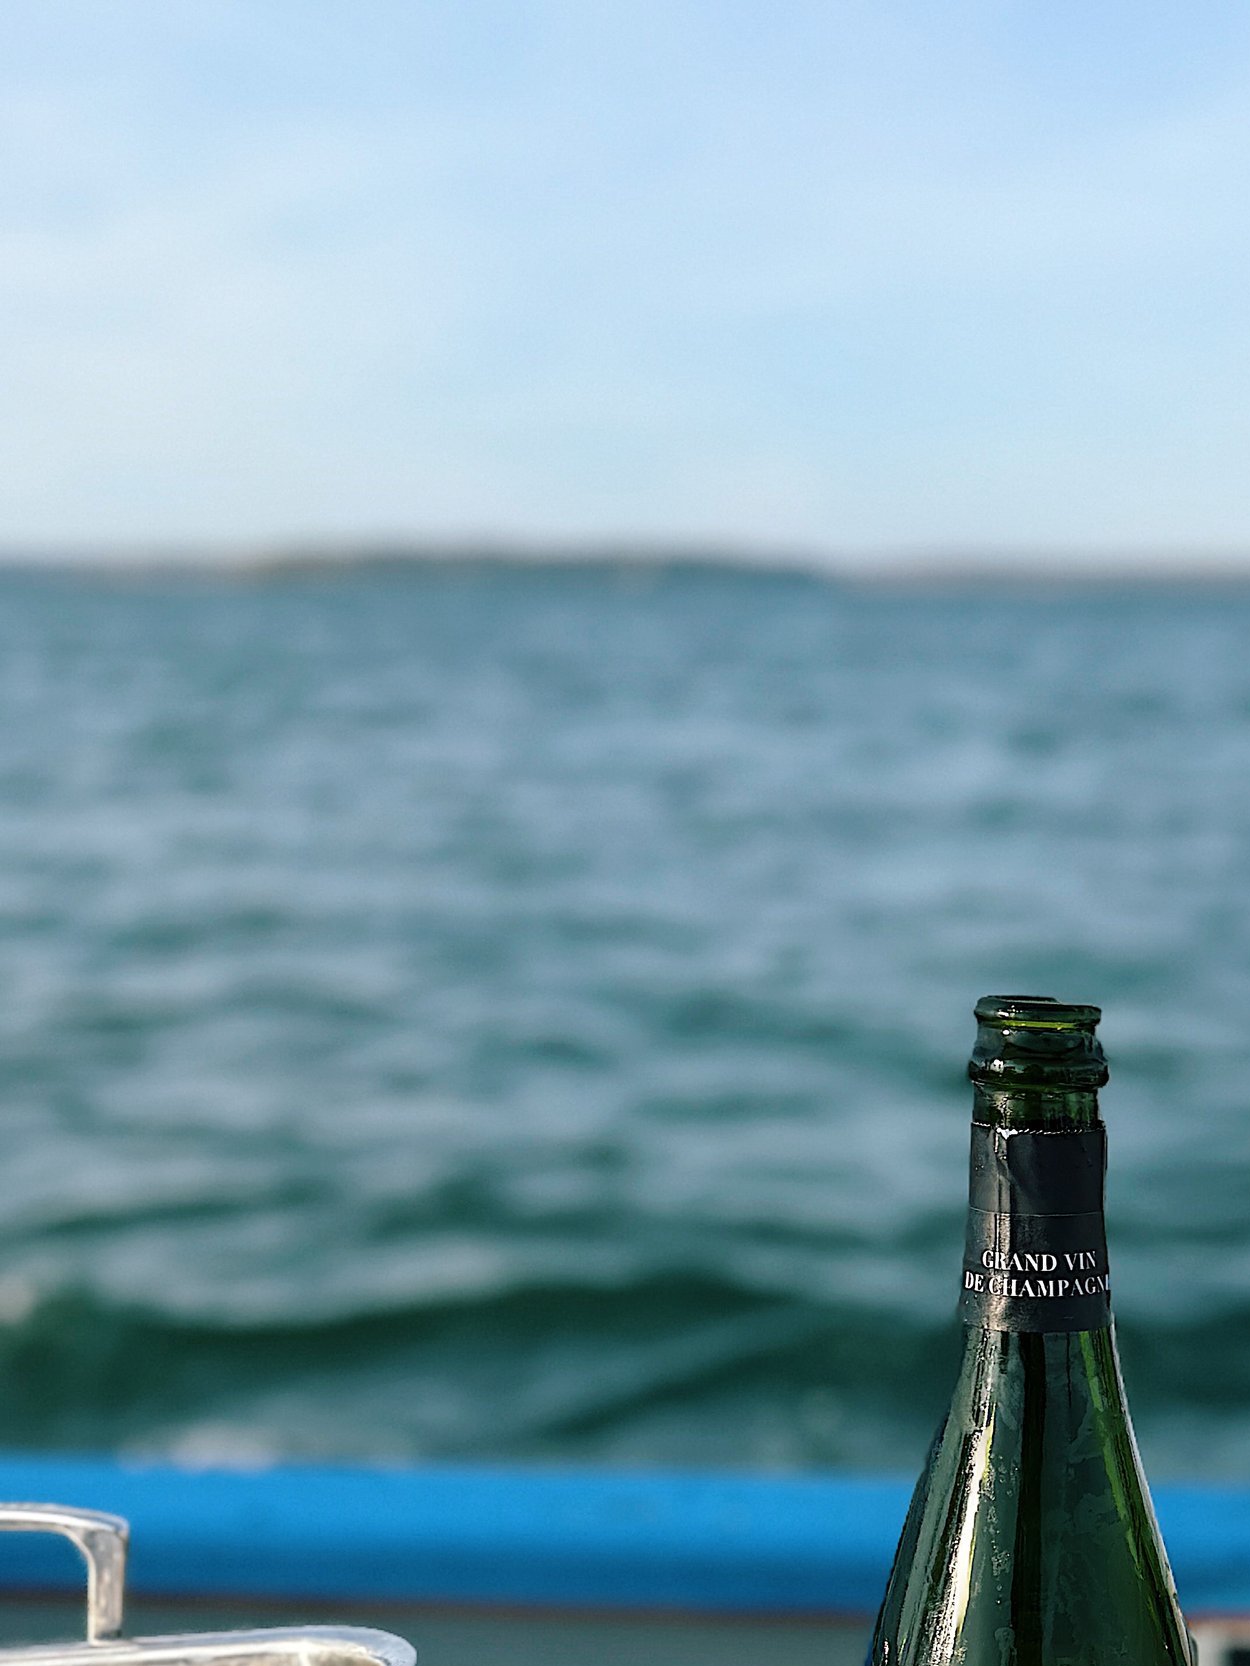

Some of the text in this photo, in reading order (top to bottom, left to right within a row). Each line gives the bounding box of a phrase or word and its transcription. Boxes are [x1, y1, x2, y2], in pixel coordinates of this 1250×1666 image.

[982, 1249, 1097, 1272] GRAND VIN
[964, 1271, 984, 1293] DE
